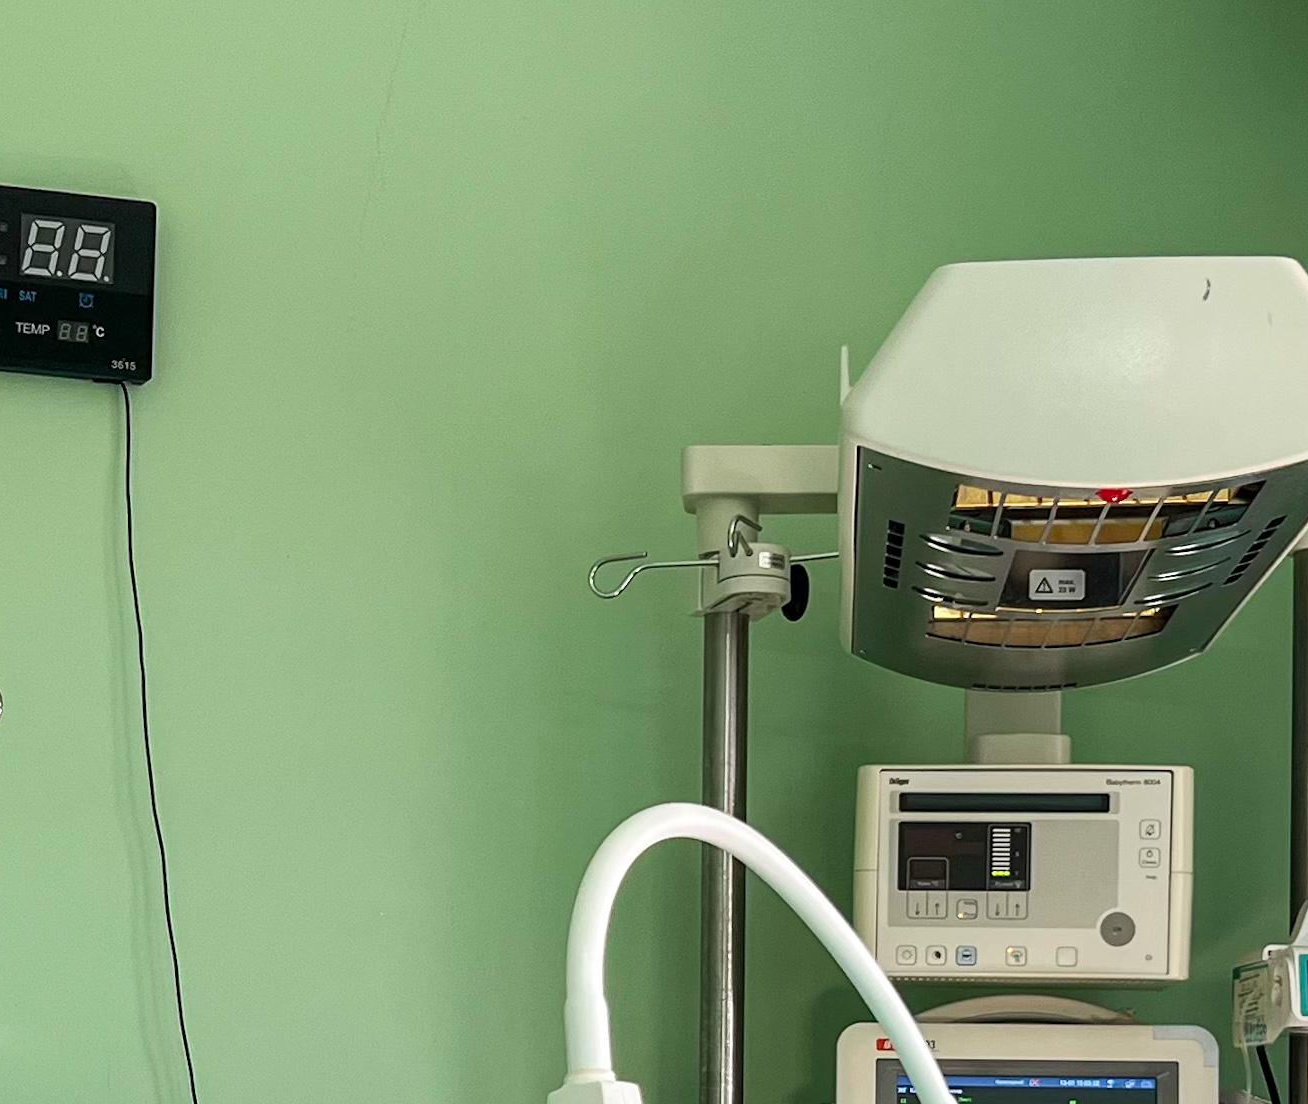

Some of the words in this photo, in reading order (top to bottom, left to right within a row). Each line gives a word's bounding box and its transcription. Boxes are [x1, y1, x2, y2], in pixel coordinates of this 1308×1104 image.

[18, 289, 38, 303] SAT
[15, 321, 51, 336] TEMP
[111, 359, 137, 371] 3615
